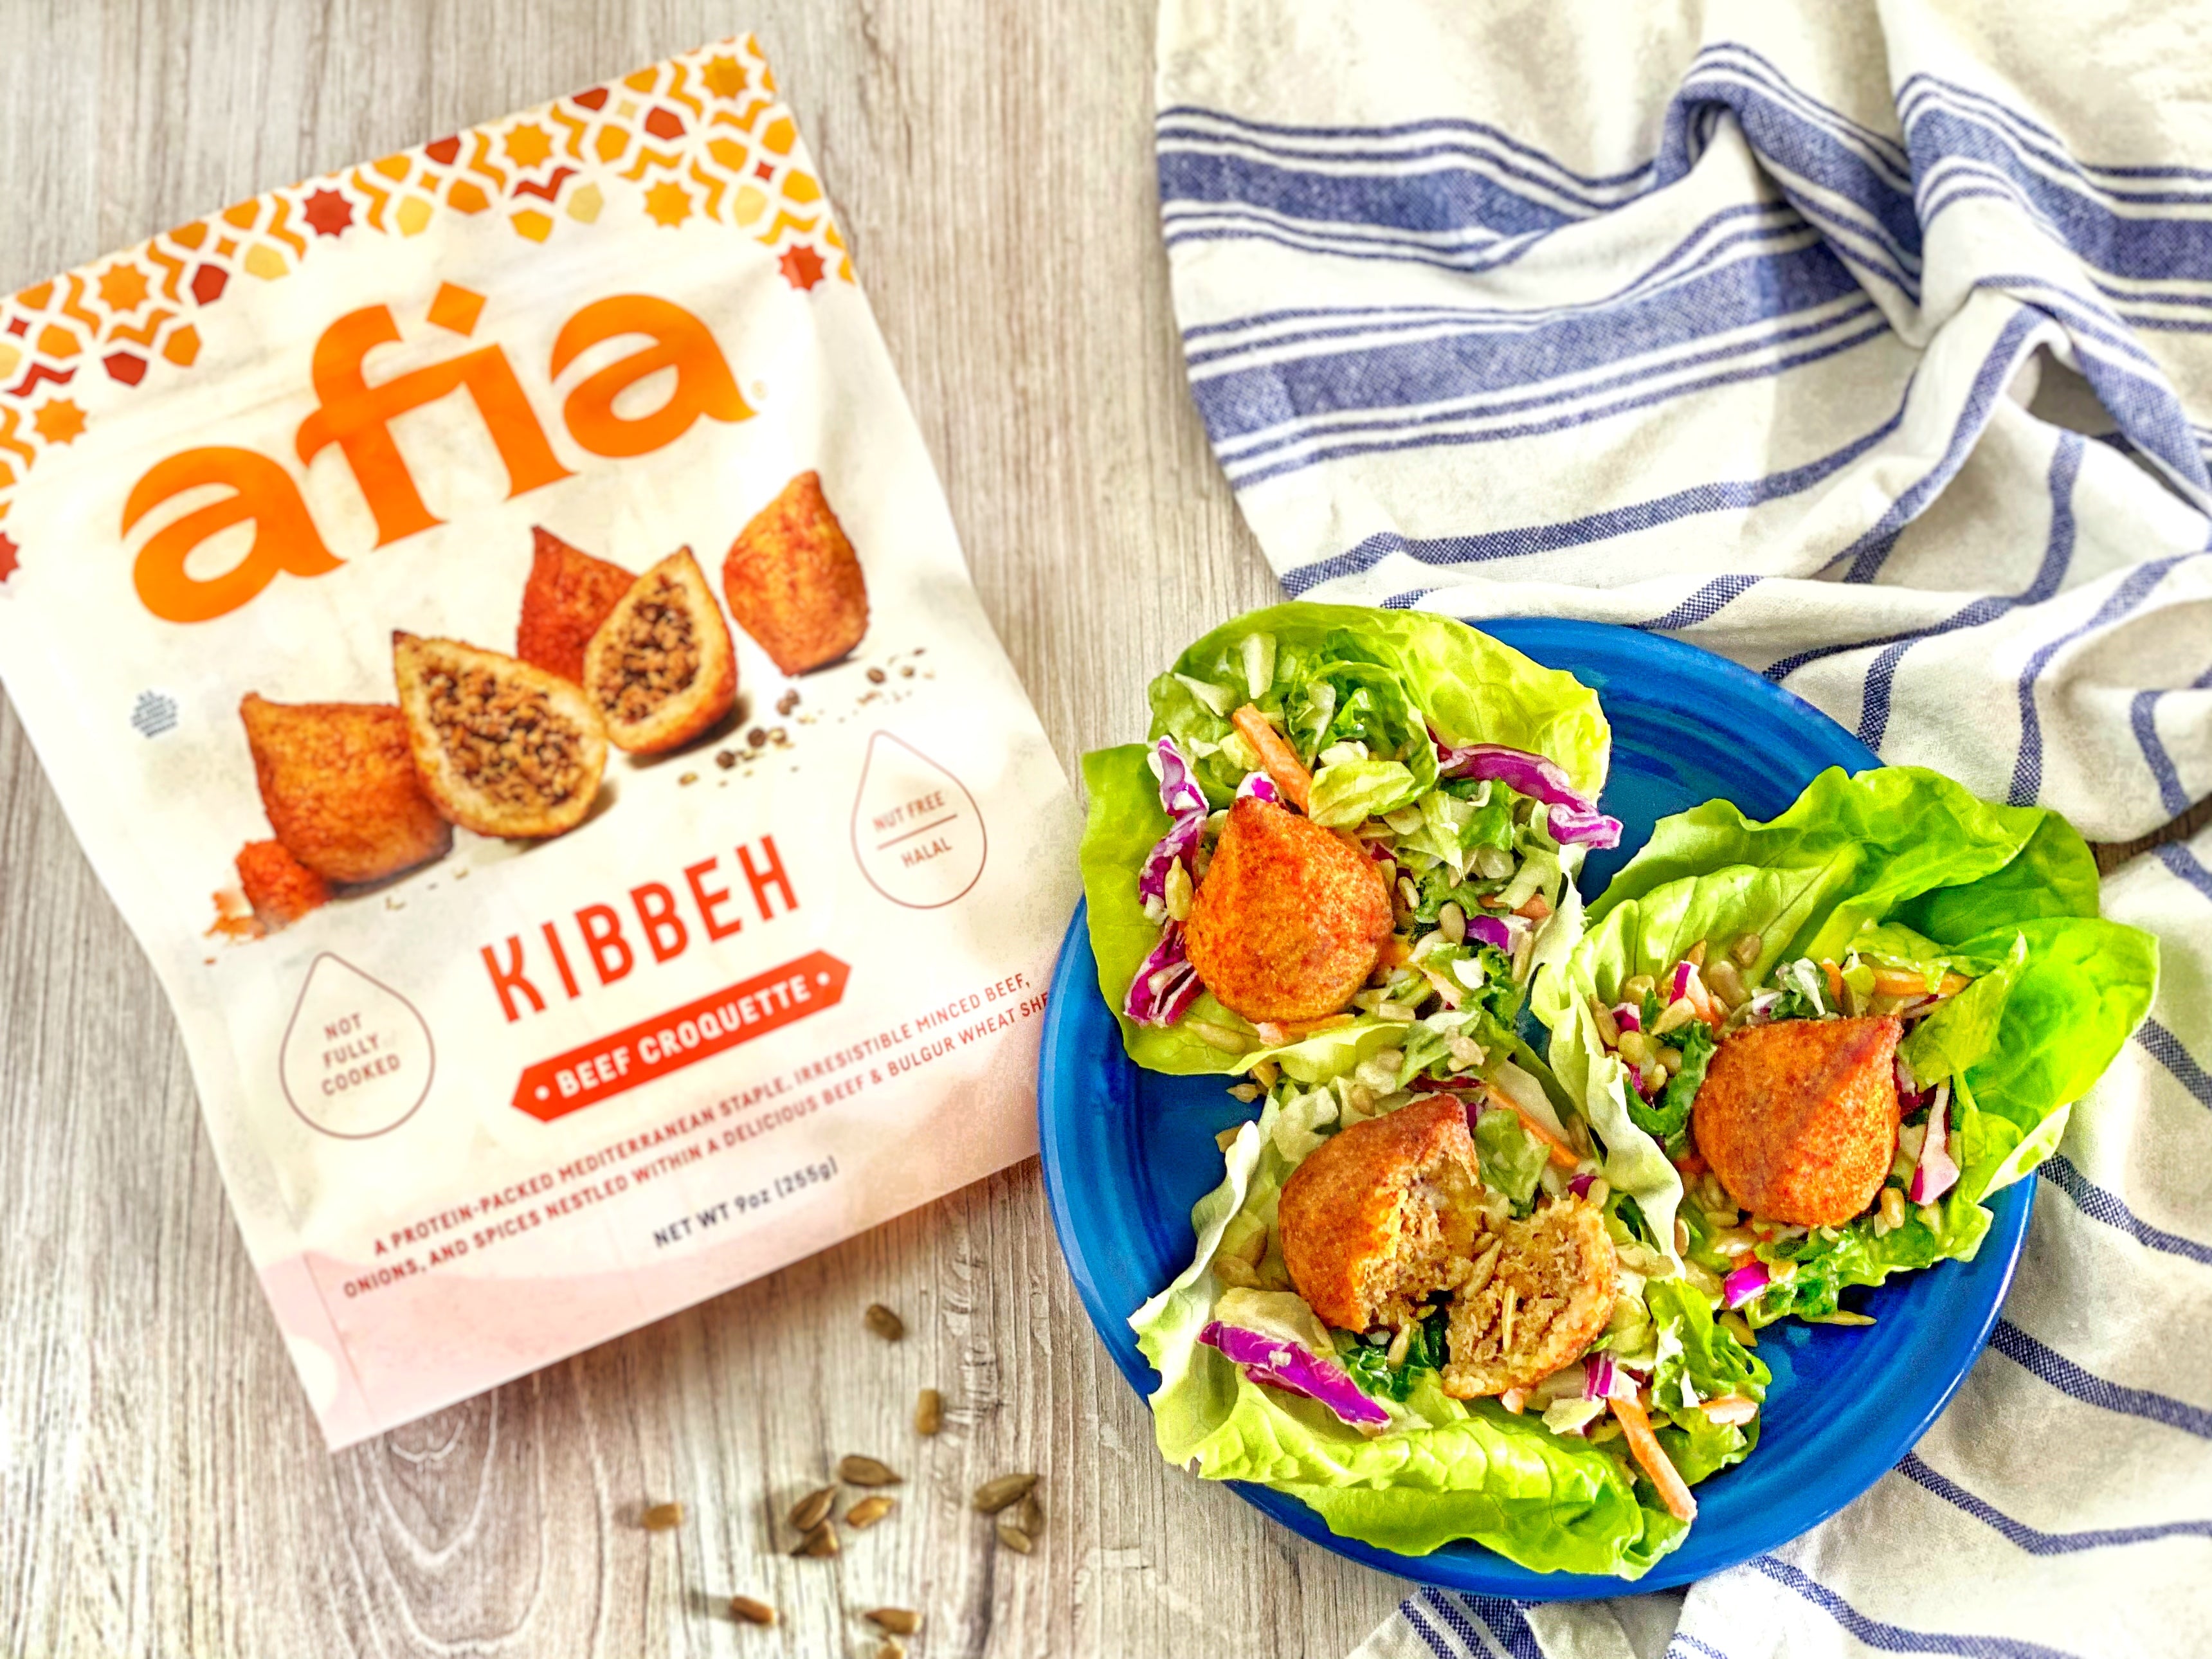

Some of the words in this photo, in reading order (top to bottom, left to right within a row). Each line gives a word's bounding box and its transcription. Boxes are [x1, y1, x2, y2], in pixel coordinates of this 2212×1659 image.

[121, 280, 760, 624] afia
[873, 806, 904, 833] NUT
[906, 790, 945, 818] FREE
[901, 837, 953, 867] HALAL
[480, 834, 800, 1023] KIBBEH
[323, 1034, 380, 1069] FULLY
[324, 1013, 362, 1040] NOT
[555, 1047, 631, 1098] BEEF
[638, 975, 811, 1064] CROQUETTE
[322, 1053, 401, 1097] COOKED
[373, 1239, 388, 1256] A
[391, 1173, 554, 1249] PROTEIN-PACKED
[558, 1101, 715, 1183] MEDITERRANEAN
[793, 1023, 912, 1085] IRRESISTIBLE
[915, 993, 981, 1033] MINCED
[984, 972, 1030, 1002] BEEF,
[343, 1257, 427, 1298] ONIONS,
[429, 1236, 469, 1265] AND
[473, 1210, 541, 1249] SPICES
[545, 1175, 630, 1219] NESTLED
[631, 1145, 703, 1183] WITHIN
[708, 1138, 720, 1154] A
[722, 1095, 819, 1147] DELICIOUS
[822, 1074, 864, 1105] BEEF
[869, 1068, 883, 1085] &
[887, 1037, 956, 1076] BULGUR
[958, 1008, 1015, 1044] WHEAT
[653, 1218, 692, 1249] NET
[694, 1201, 730, 1229] WT
[734, 1189, 770, 1215] 9oz
[774, 1155, 838, 1199] (255g)
